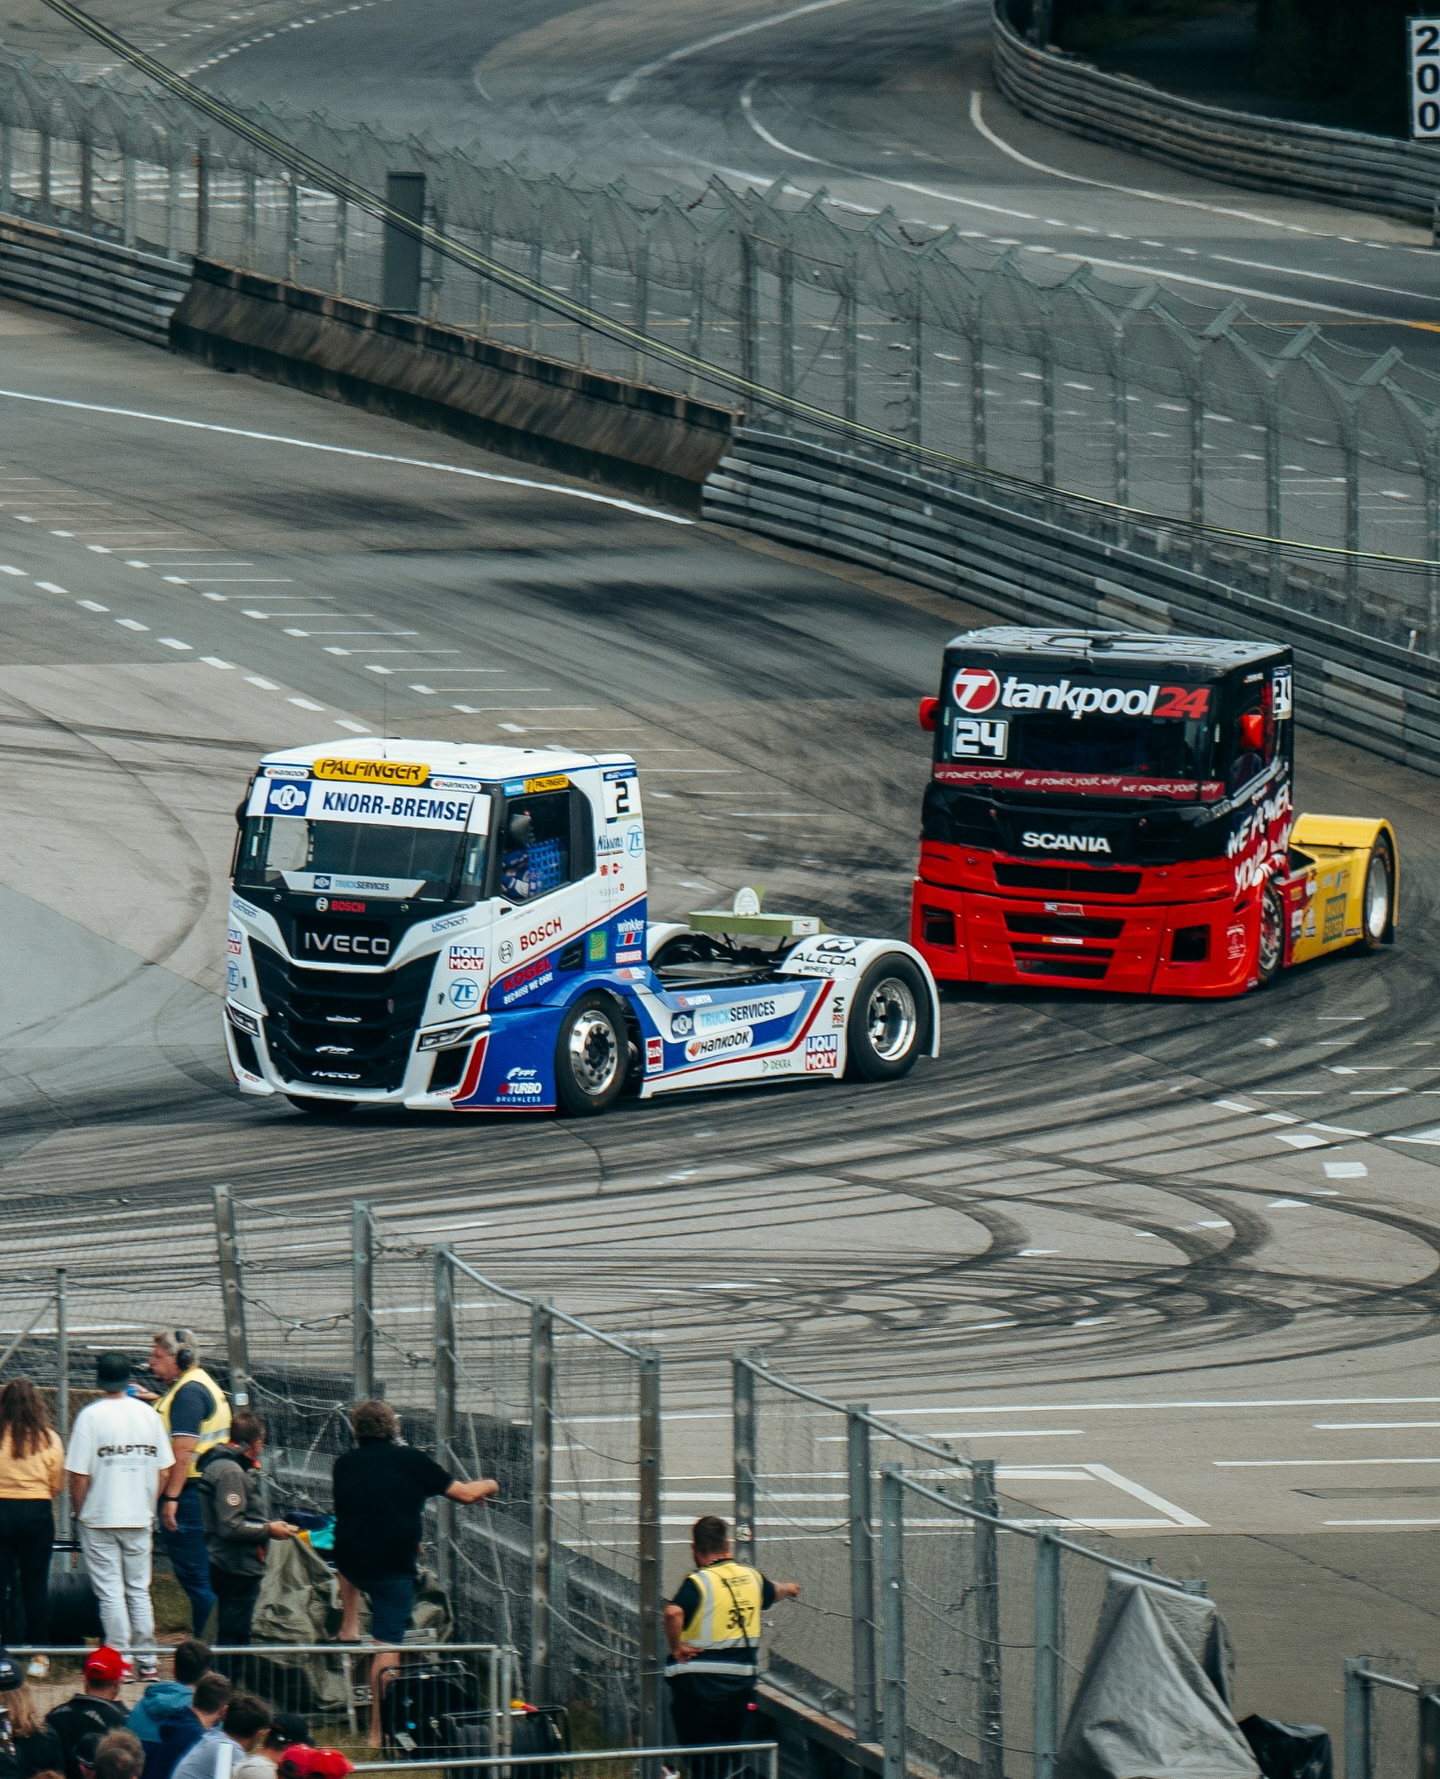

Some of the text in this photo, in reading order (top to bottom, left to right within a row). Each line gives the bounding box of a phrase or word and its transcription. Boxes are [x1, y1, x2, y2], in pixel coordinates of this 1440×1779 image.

[1415, 26, 1440, 132] 200
[955, 720, 1005, 756] 24
[320, 759, 421, 780] PALFINGER
[322, 791, 470, 822] KNORR-BREMSE
[615, 780, 630, 814] 2
[628, 831, 644, 852] ZF
[1021, 831, 1112, 853] SCANIA
[331, 900, 366, 912] BOSCH
[304, 932, 390, 955] IVECO
[520, 916, 562, 951] BOSCH
[450, 947, 484, 958] LIQUI
[790, 952, 857, 967] ALCOA
[449, 958, 484, 969] MOLY
[452, 984, 477, 1003] ZF
[808, 1035, 837, 1052] LIQUI
[807, 1053, 837, 1070] MOLY
[508, 1082, 542, 1095] TURBO
[97, 1444, 158, 1458] CHAPTER
